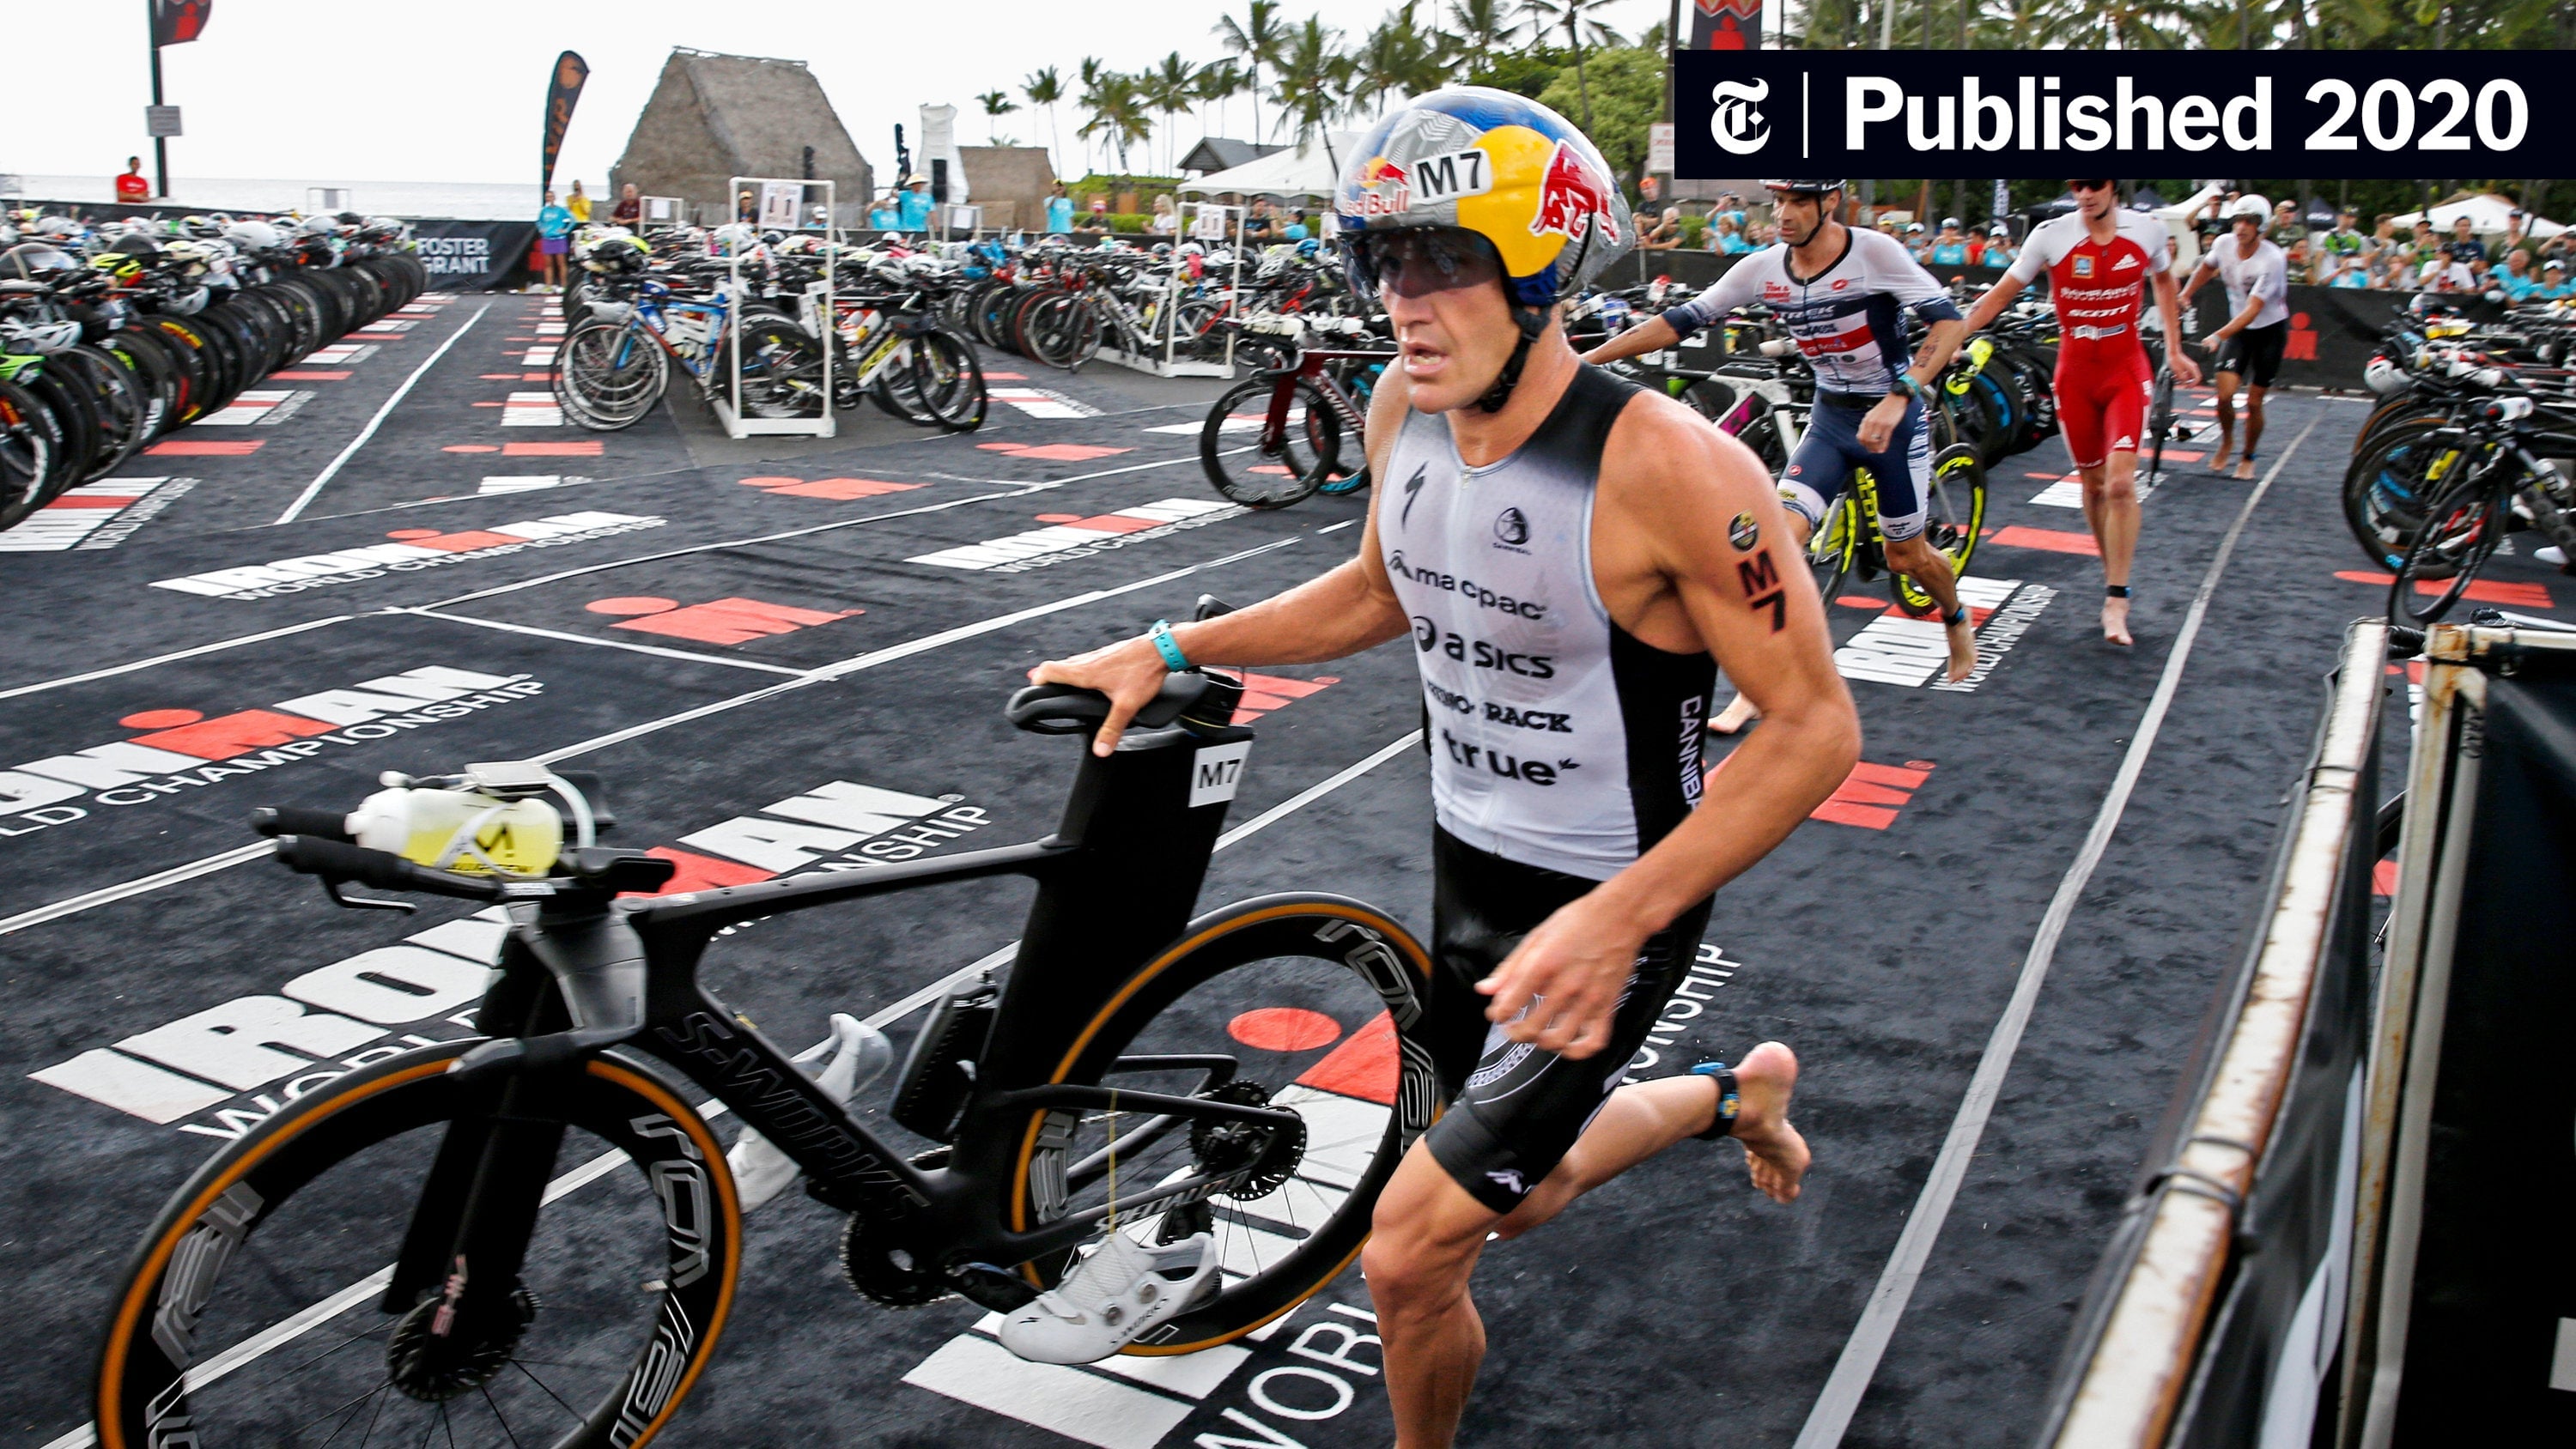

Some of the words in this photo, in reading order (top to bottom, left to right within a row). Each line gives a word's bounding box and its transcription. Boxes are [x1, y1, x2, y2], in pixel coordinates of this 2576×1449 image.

[1418, 151, 1482, 198] M7
[1368, 188, 1410, 215] Bull
[416, 237, 489, 256] FOSTER
[420, 256, 489, 275] GRANT
[2067, 303, 2132, 318] SCOTT
[148, 510, 648, 597] IRONMAN
[902, 498, 1241, 571] IRONMAN
[220, 568, 387, 600] WORLD
[1738, 549, 1780, 598] M
[1751, 589, 1787, 634] 7
[94, 680, 544, 806] CHAMPIONSHIP
[1442, 727, 1557, 786] true
[1199, 757, 1239, 790] M7
